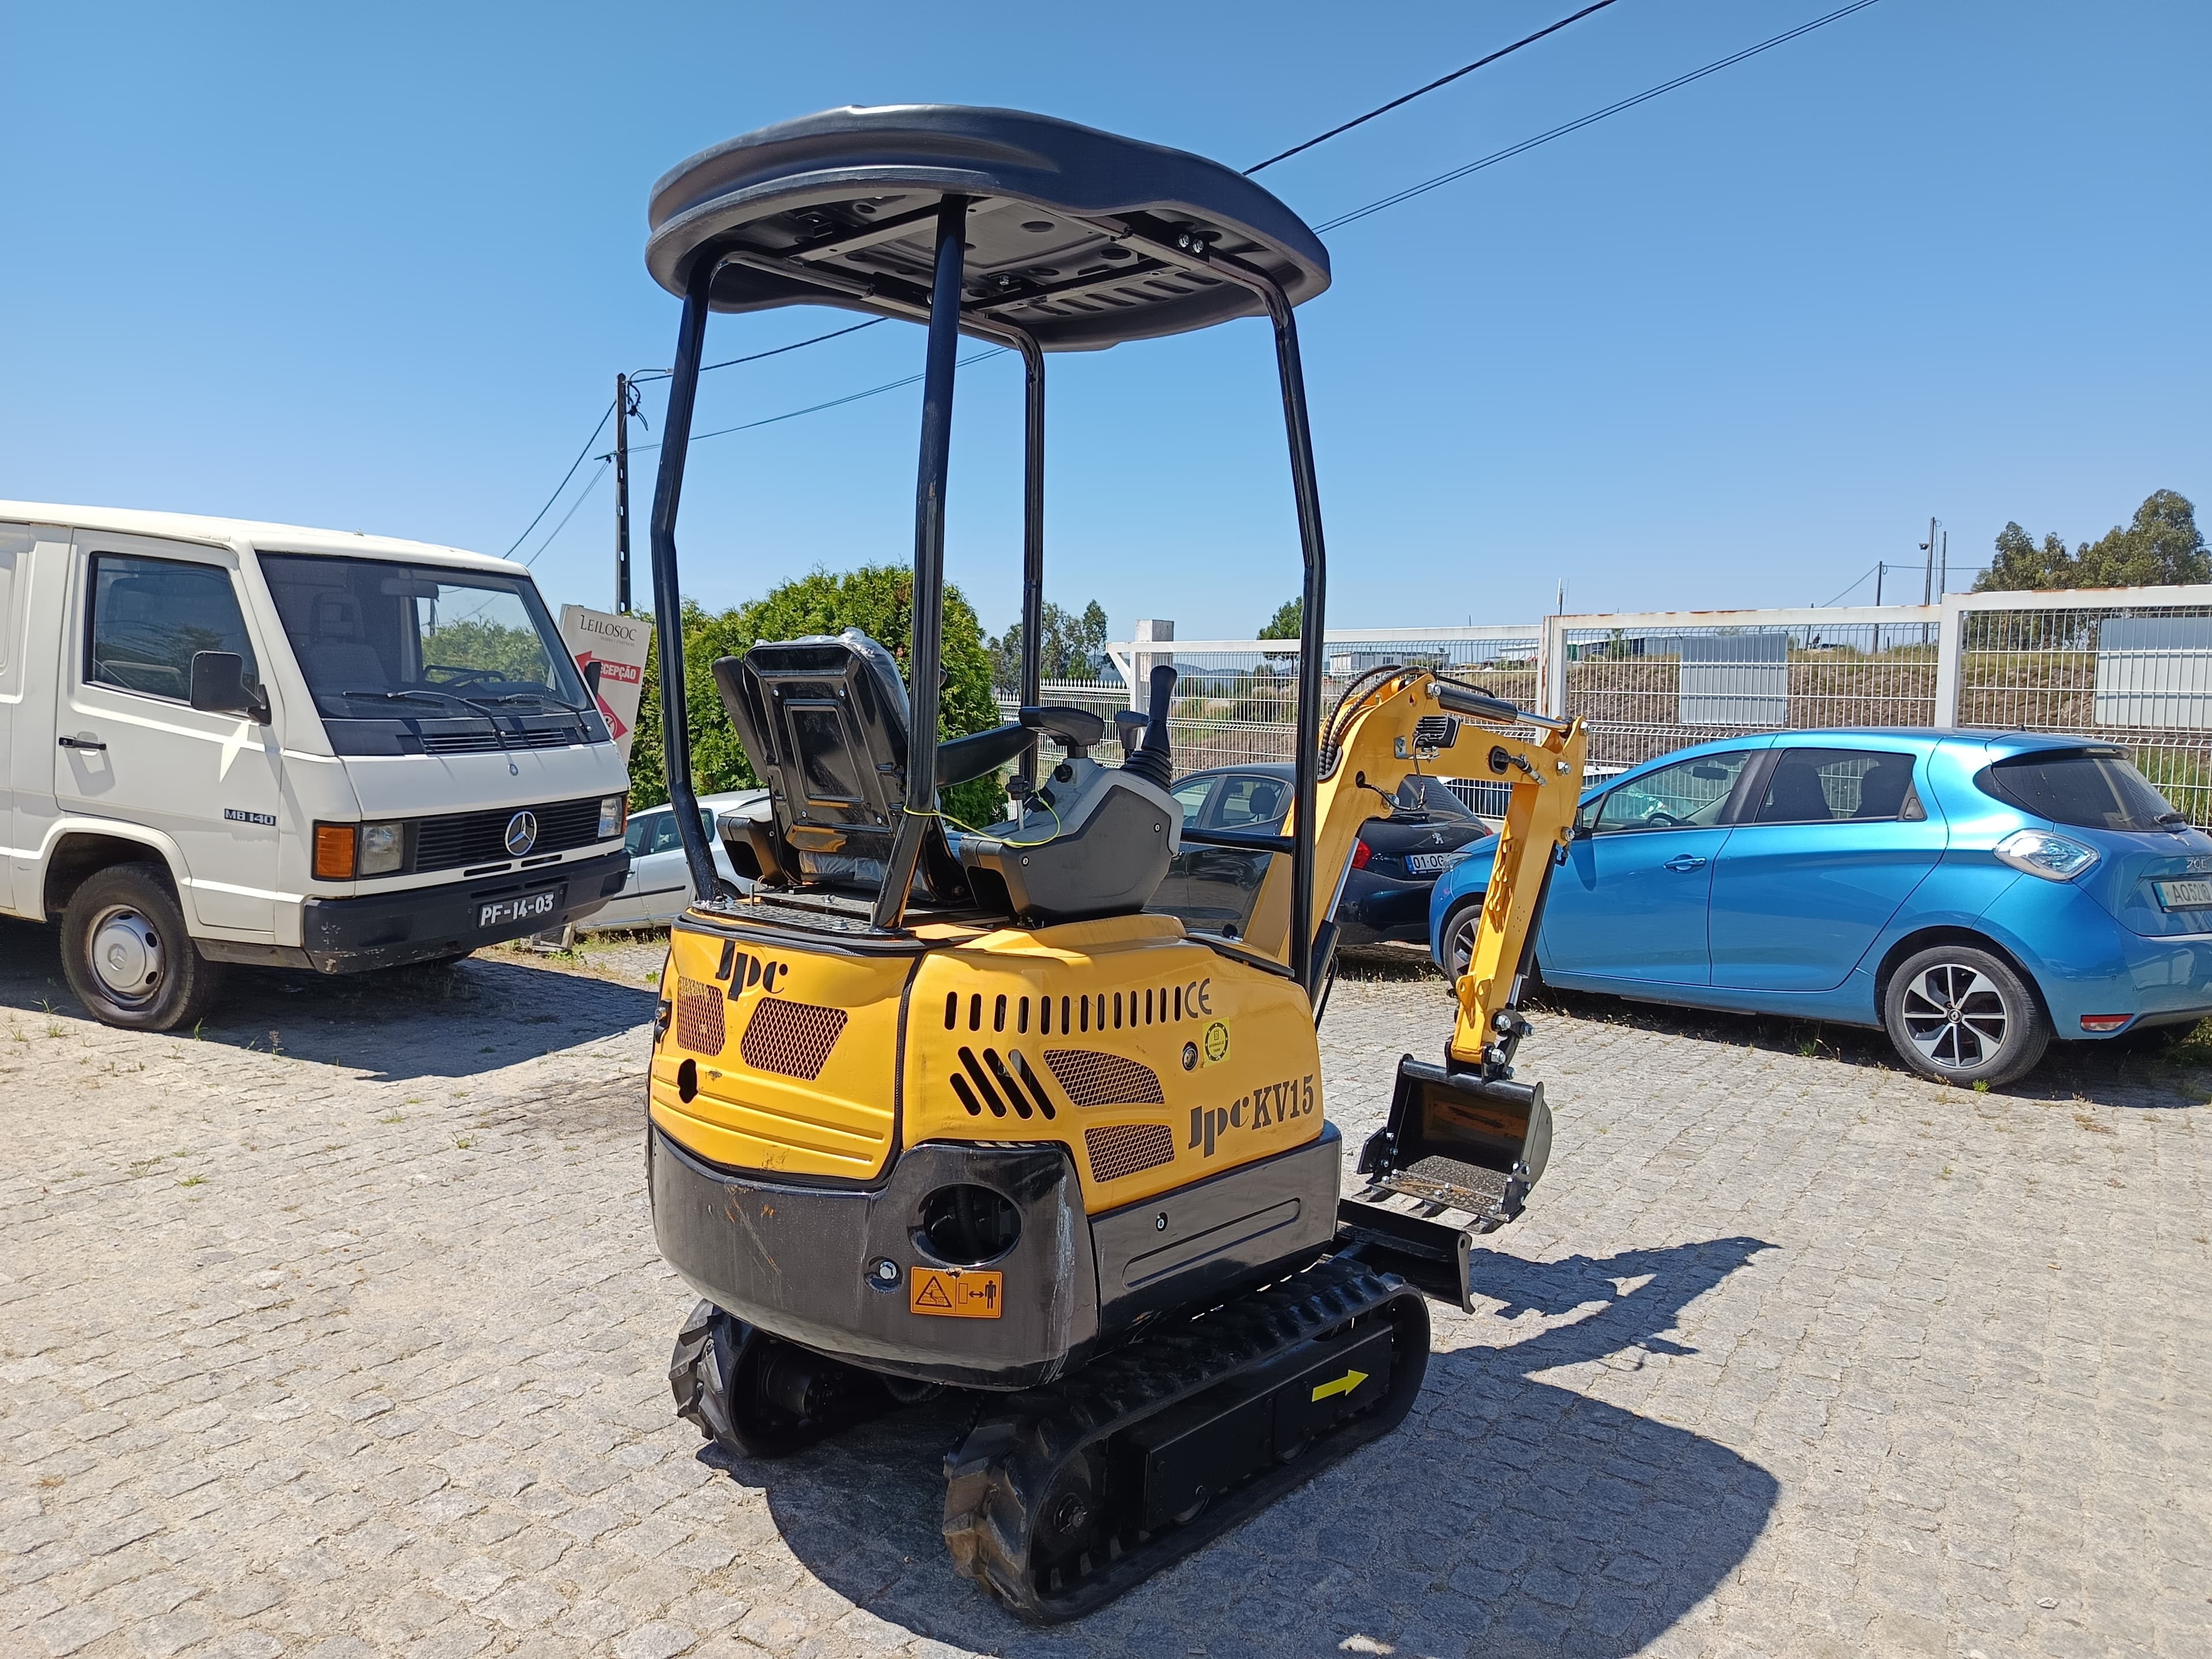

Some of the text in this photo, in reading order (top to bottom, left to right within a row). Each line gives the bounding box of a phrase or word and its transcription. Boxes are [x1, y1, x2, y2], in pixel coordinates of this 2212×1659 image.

[581, 614, 637, 641] LEILOSOC
[600, 663, 637, 680] CEPÇÃO
[225, 809, 274, 825] MB 140
[480, 893, 554, 926] PF-14-03
[1184, 978, 1212, 1018] CE
